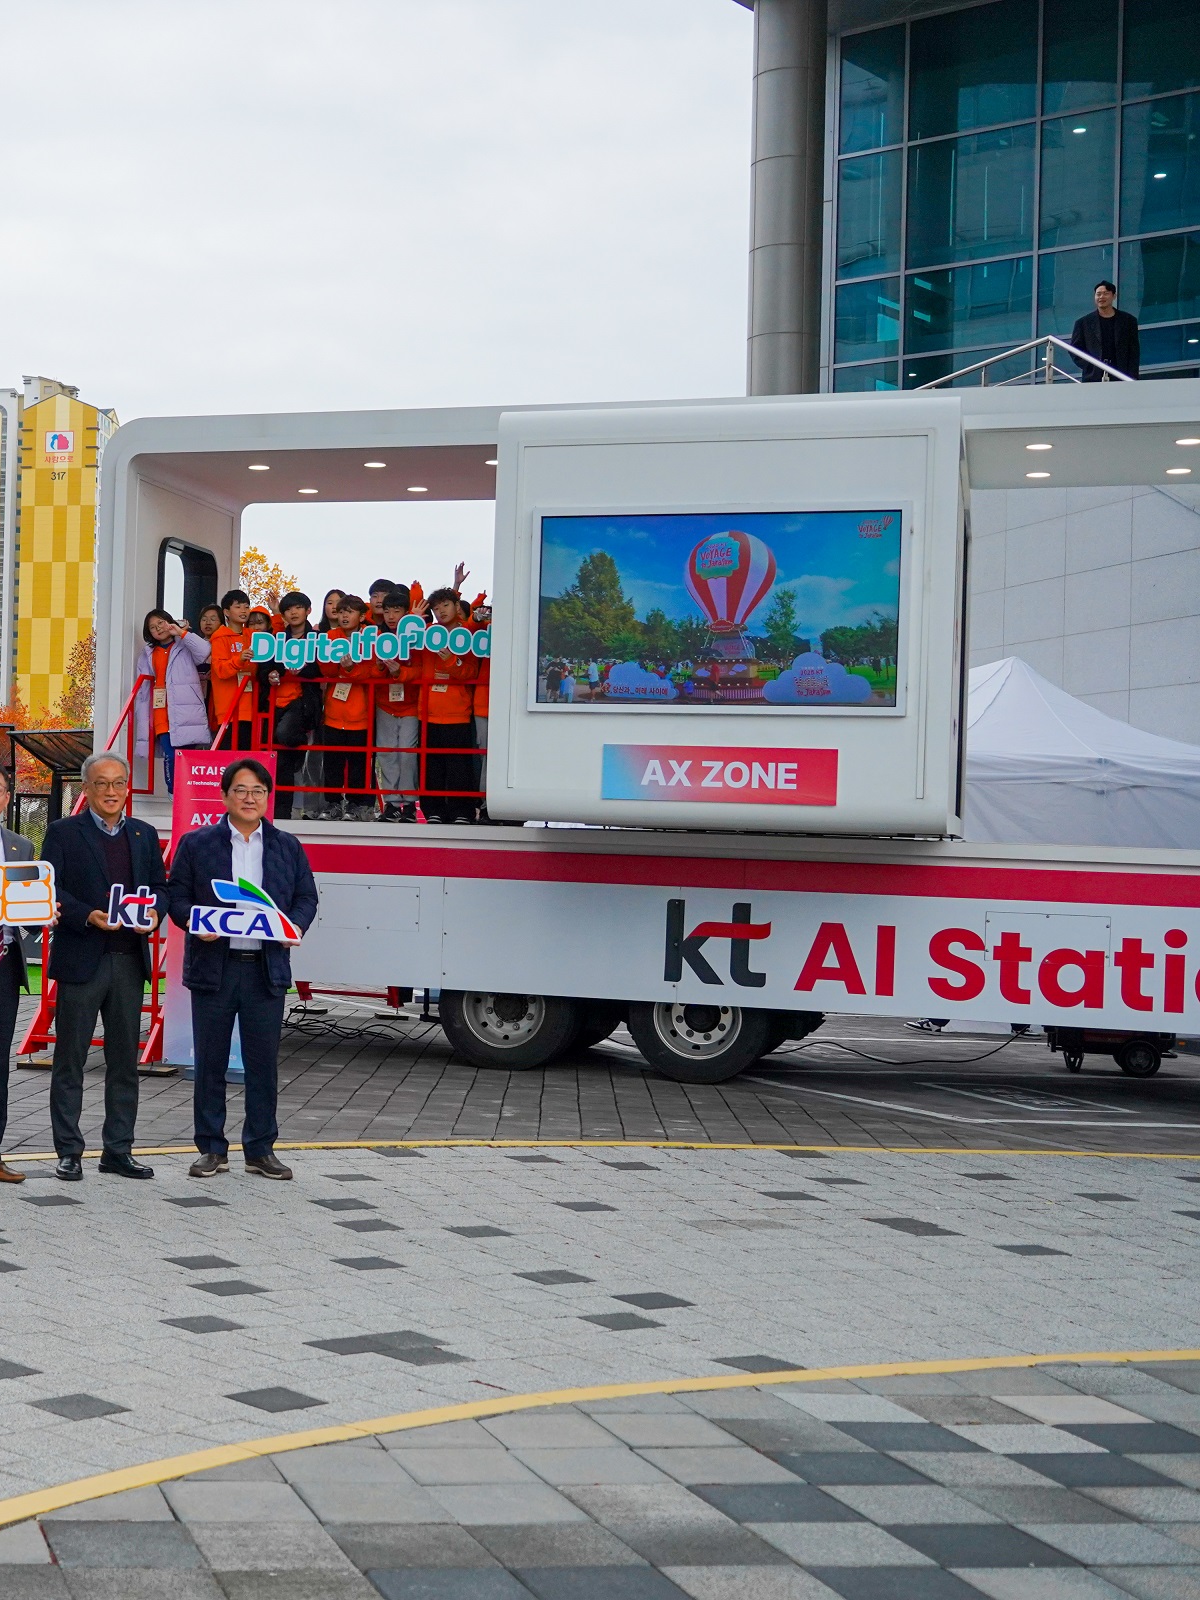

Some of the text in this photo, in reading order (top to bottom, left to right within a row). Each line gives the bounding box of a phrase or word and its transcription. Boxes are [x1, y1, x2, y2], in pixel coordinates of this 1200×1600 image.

[51, 471, 66, 481] 317
[191, 765, 206, 775] KT
[206, 766, 218, 775] AI
[640, 759, 798, 790] AX ZONE
[190, 813, 213, 826] AX
[110, 886, 155, 927] kt
[191, 907, 275, 938] KCA
[663, 899, 1200, 1015] kt AI Stati
